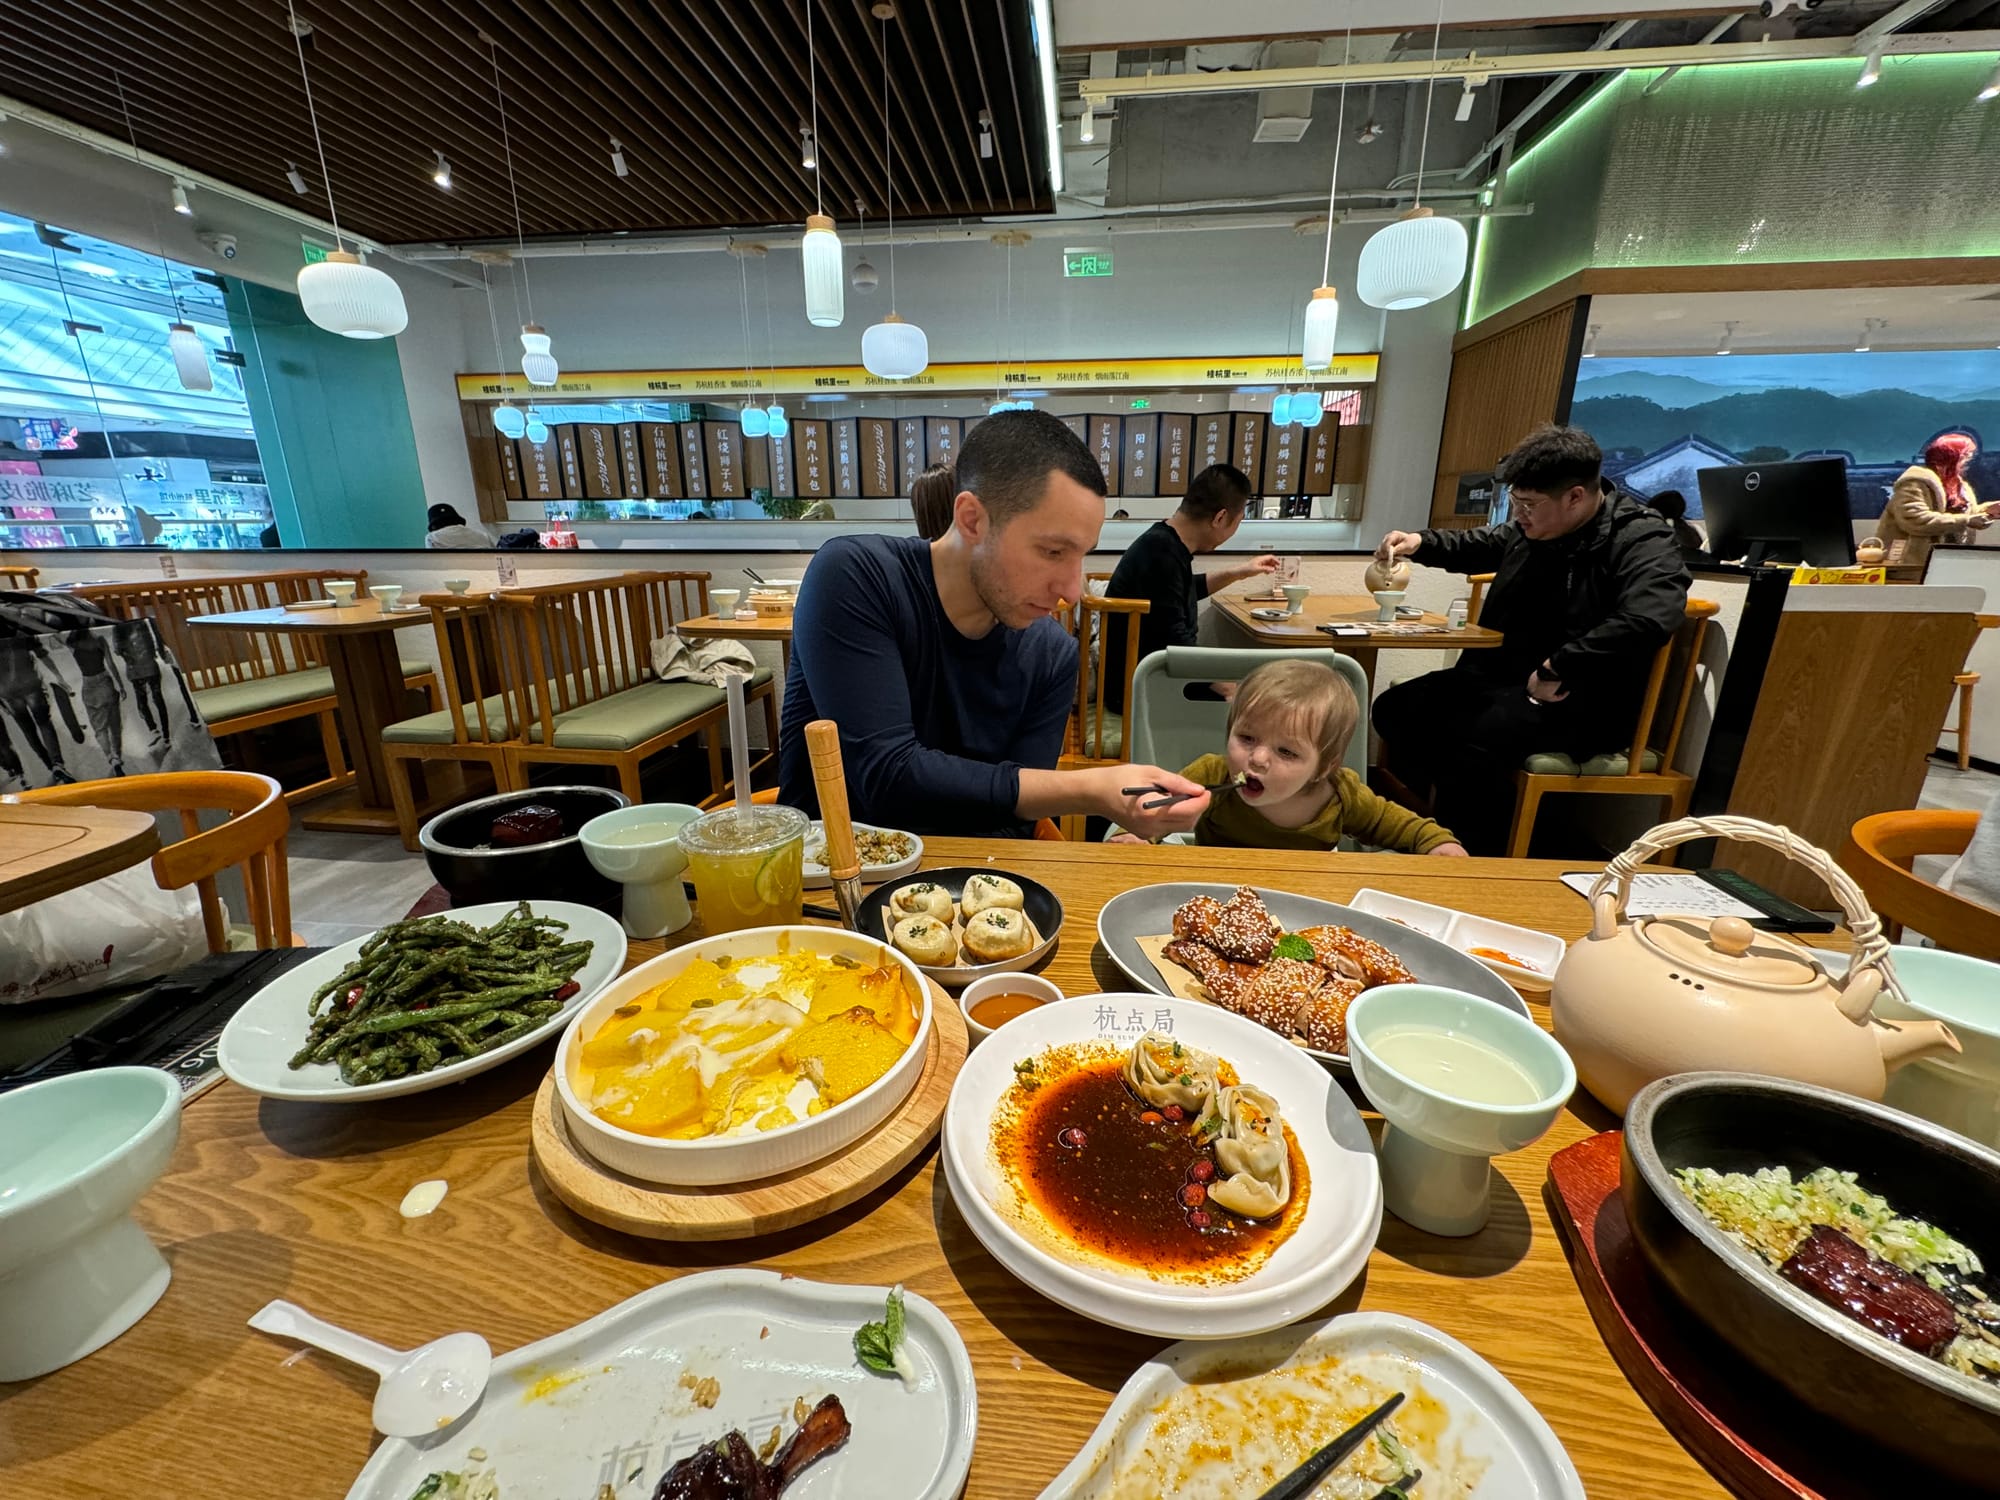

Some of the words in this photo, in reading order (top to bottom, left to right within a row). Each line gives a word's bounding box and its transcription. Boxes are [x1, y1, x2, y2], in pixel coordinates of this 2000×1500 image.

[716, 428, 733, 492] 红烧狮子头
[805, 425, 820, 491] 鲜肉小笼包
[1100, 422, 1111, 486] 老头油爆
[1314, 433, 1328, 474] 东坡肉
[1093, 1004, 1175, 1034] 杭点局
